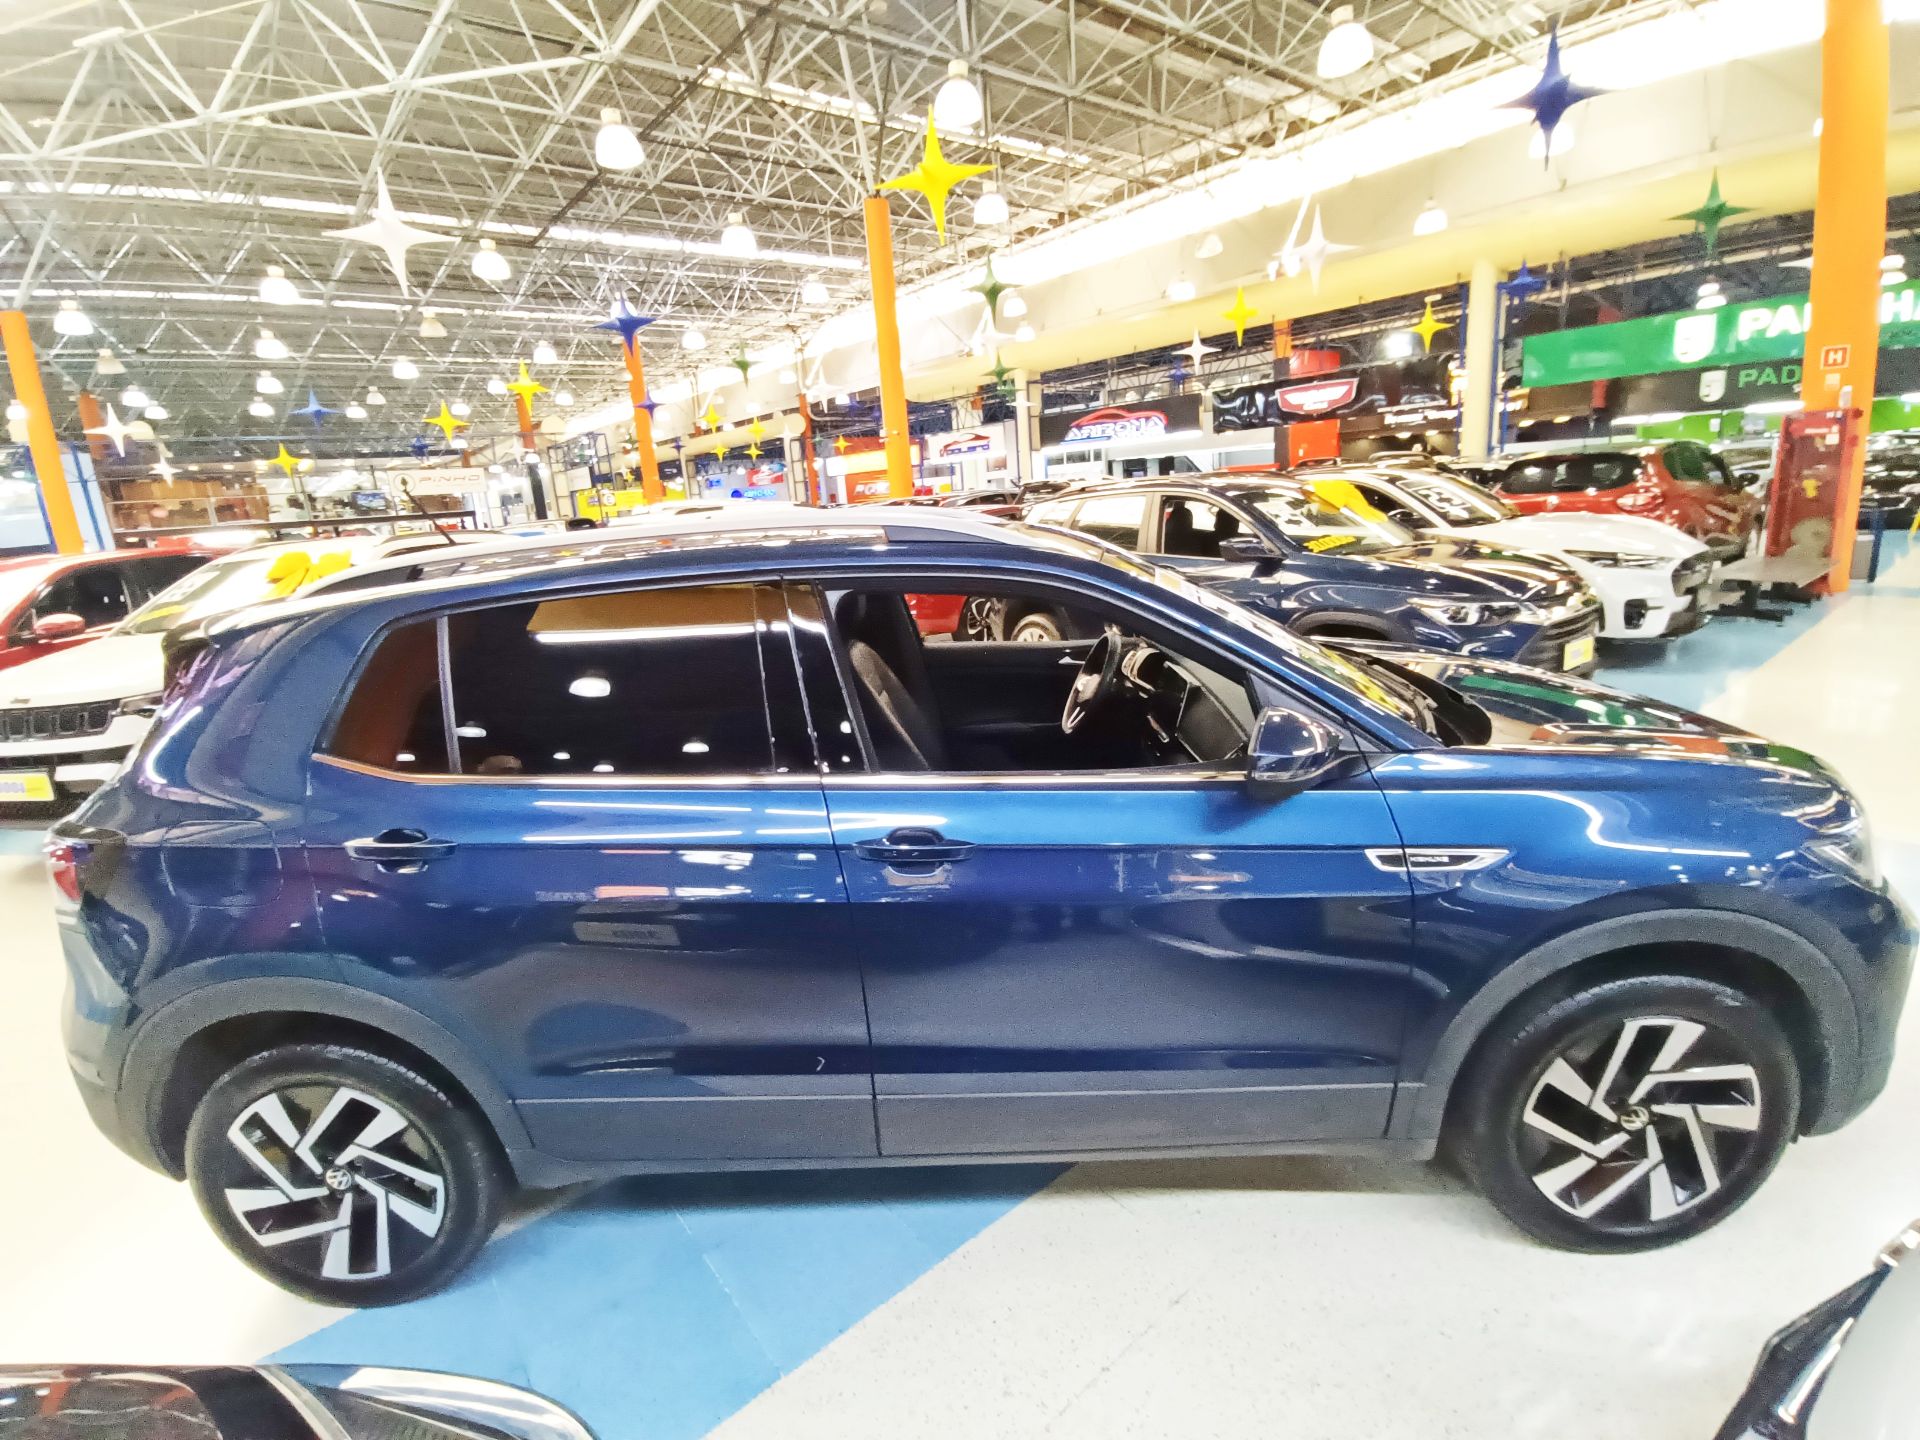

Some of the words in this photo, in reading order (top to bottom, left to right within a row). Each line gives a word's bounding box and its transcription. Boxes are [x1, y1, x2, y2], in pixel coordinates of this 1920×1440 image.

[1738, 303, 1812, 341] PA
[1880, 289, 1920, 324] H
[1828, 350, 1843, 365] H
